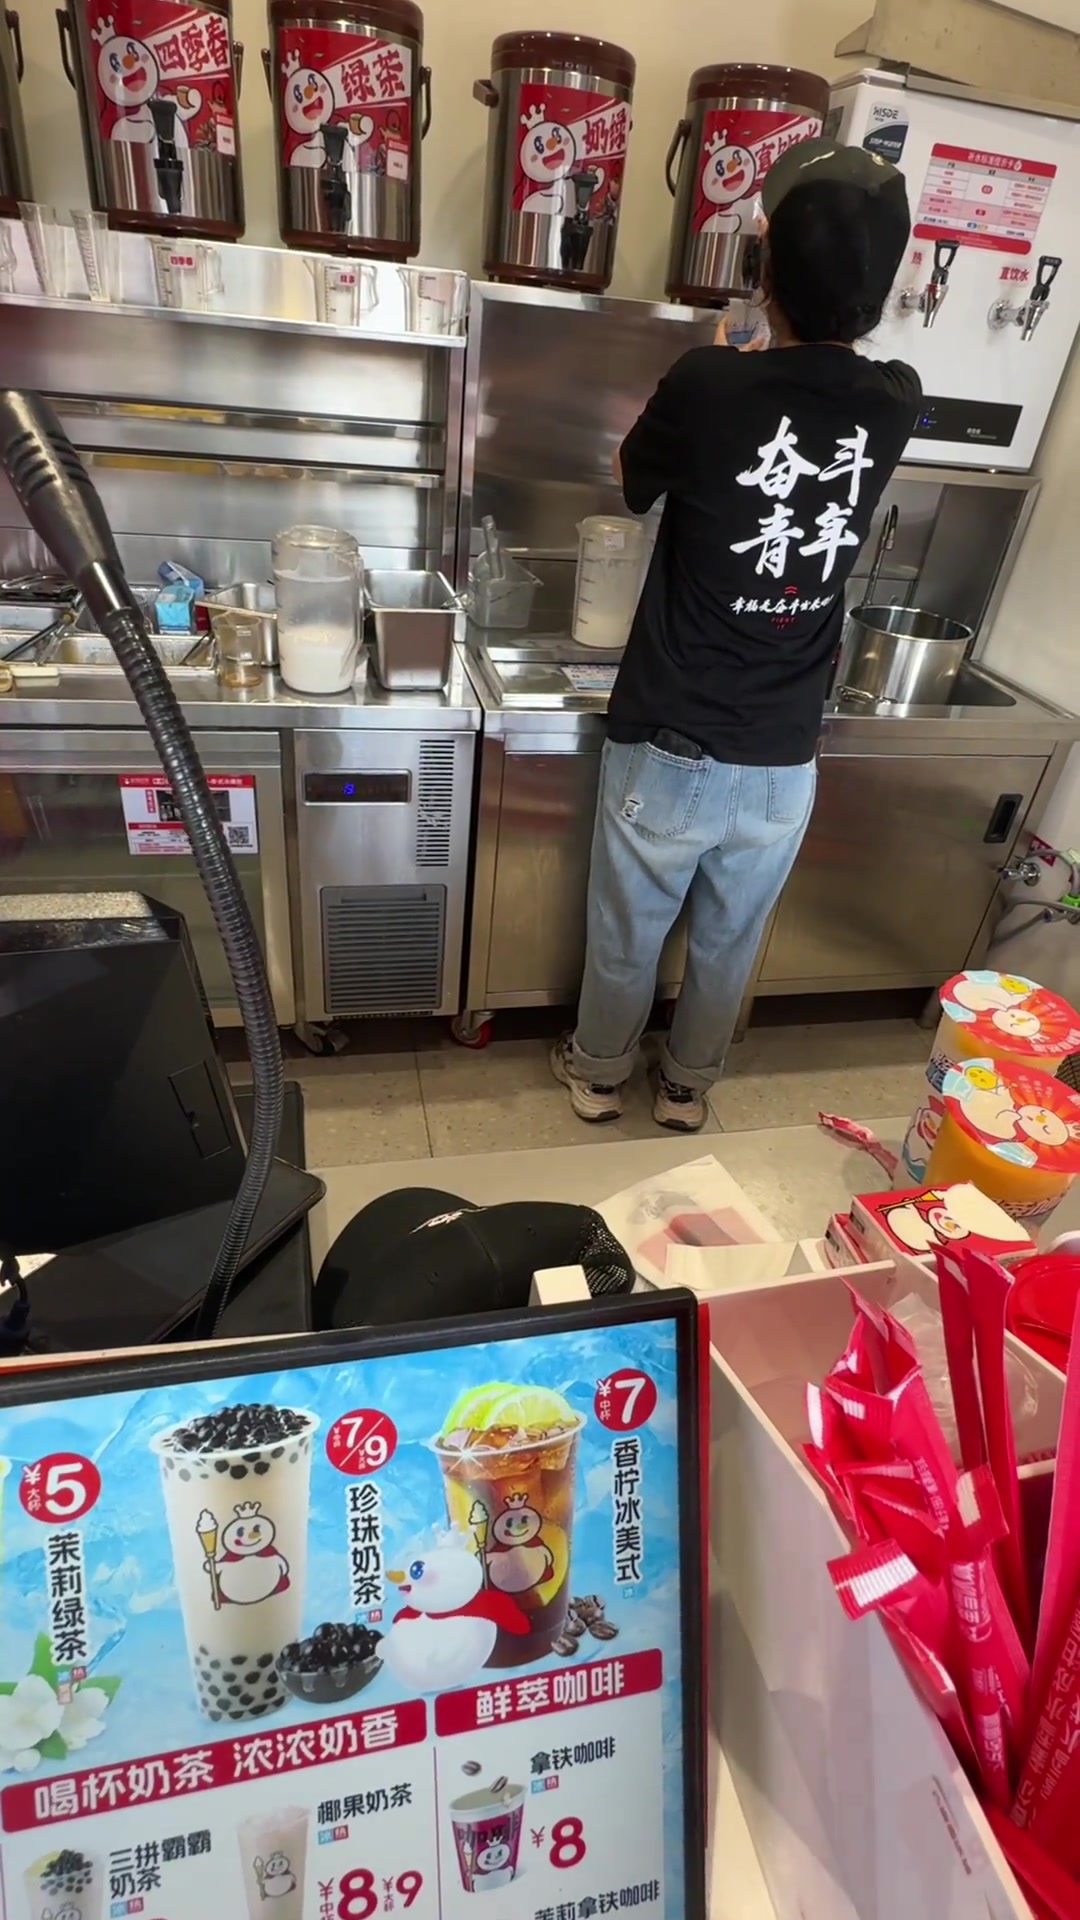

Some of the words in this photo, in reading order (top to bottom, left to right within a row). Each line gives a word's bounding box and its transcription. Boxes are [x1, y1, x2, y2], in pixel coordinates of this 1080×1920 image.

[153, 15, 229, 73] 四季春
[341, 49, 406, 104] 绿茶
[582, 107, 627, 155] 奶绿
[735, 415, 875, 508] 奋斗
[729, 501, 860, 584] 青年
[614, 1438, 642, 1583] 香柠冰美式
[349, 1483, 382, 1606] 珍珠奶茶
[48, 1531, 88, 1663] 茉莉绿茶
[476, 1661, 625, 1726] 鲜萃咖啡
[34, 1749, 214, 1821] 喝杯奶茶
[233, 1709, 399, 1778] 浓浓奶香
[530, 1736, 617, 1775] 拿铁咖啡
[317, 1782, 413, 1825] 椰果奶茶
[108, 1829, 212, 1875] 三拼霸霸
[530, 1816, 587, 1869] ¥8
[109, 1866, 162, 1900] 奶茶
